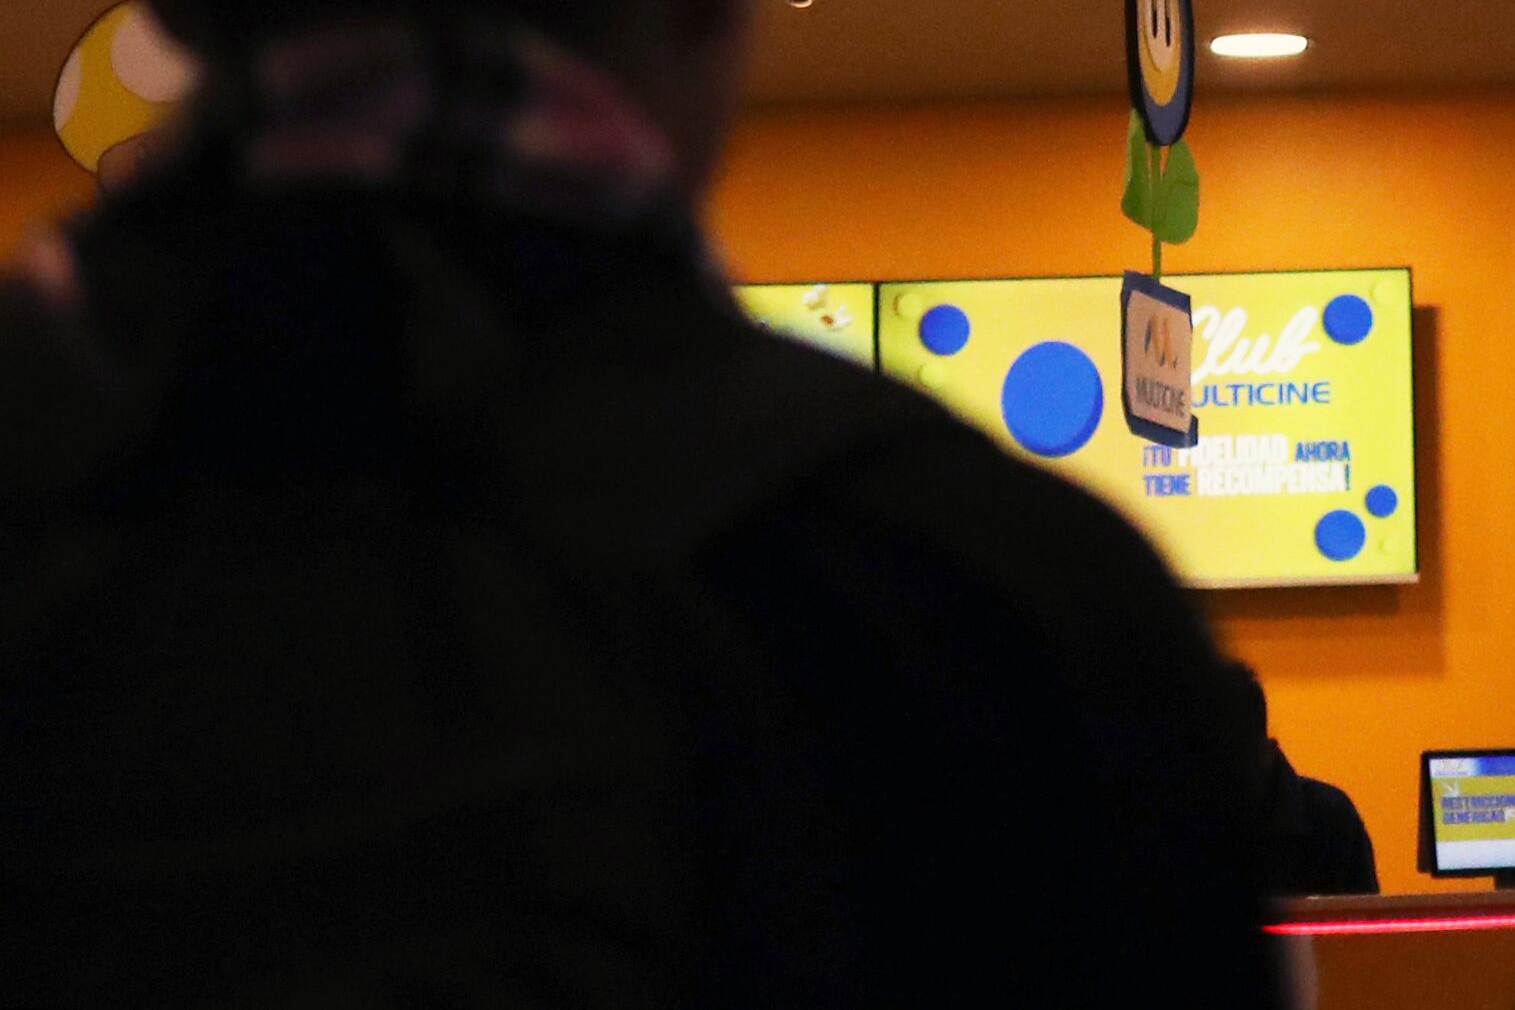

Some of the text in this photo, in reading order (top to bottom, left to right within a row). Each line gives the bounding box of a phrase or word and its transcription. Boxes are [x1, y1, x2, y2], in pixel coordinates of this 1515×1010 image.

[1191, 381, 1330, 408] ULTICINE
[1295, 441, 1350, 462] AHORA
[1142, 473, 1192, 496] TIENE
